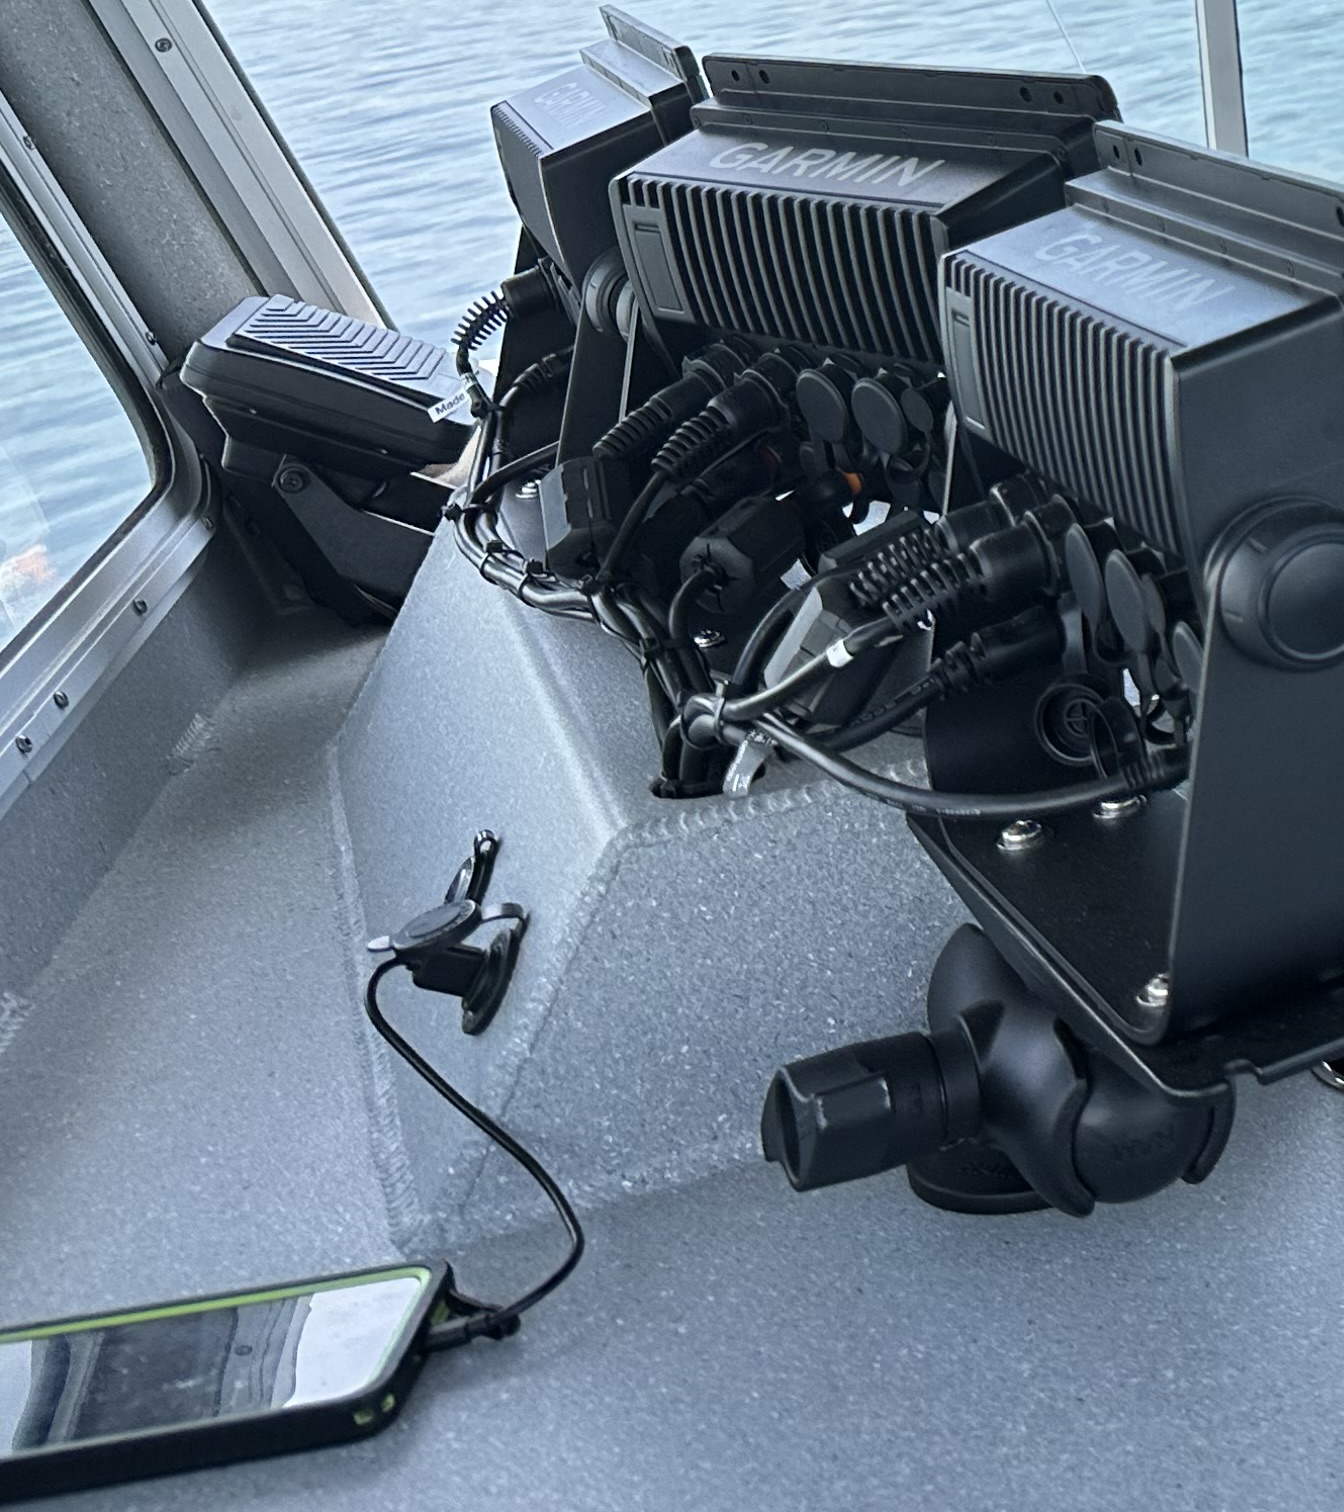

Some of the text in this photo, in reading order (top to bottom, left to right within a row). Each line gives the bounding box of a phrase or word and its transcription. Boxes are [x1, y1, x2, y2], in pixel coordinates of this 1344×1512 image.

[709, 141, 946, 187] GARMIN
[1034, 232, 1237, 312] GARMIN
[435, 392, 466, 416] Made
